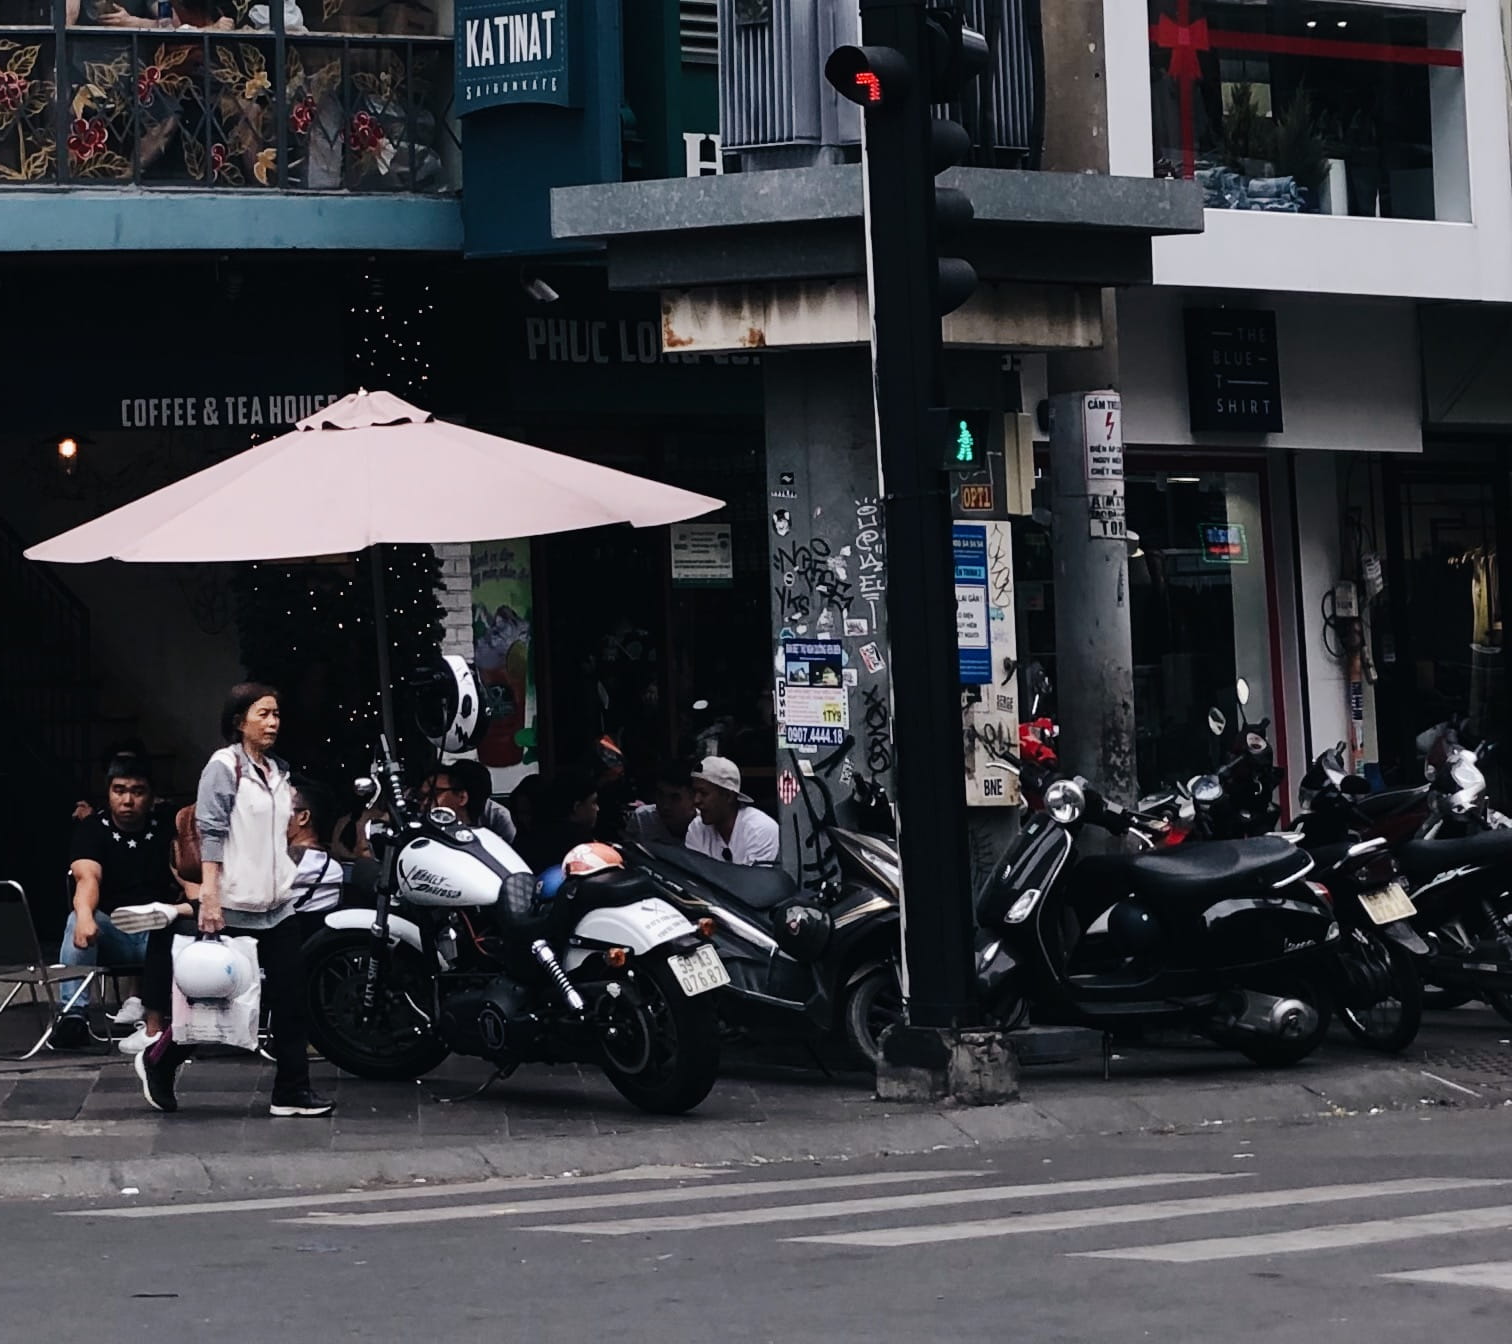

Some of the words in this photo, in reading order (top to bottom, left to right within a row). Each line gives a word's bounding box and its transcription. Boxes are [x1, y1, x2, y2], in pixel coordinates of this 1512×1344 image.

[465, 9, 556, 69] KATINAT
[1237, 326, 1268, 344] THE
[1212, 348, 1253, 367] BLUE
[1215, 373, 1224, 391] T
[121, 396, 199, 429] COFFEE
[202, 395, 220, 427] &
[224, 394, 264, 426] TEA
[1216, 397, 1271, 415] SHIRT
[983, 778, 1003, 796] BNE
